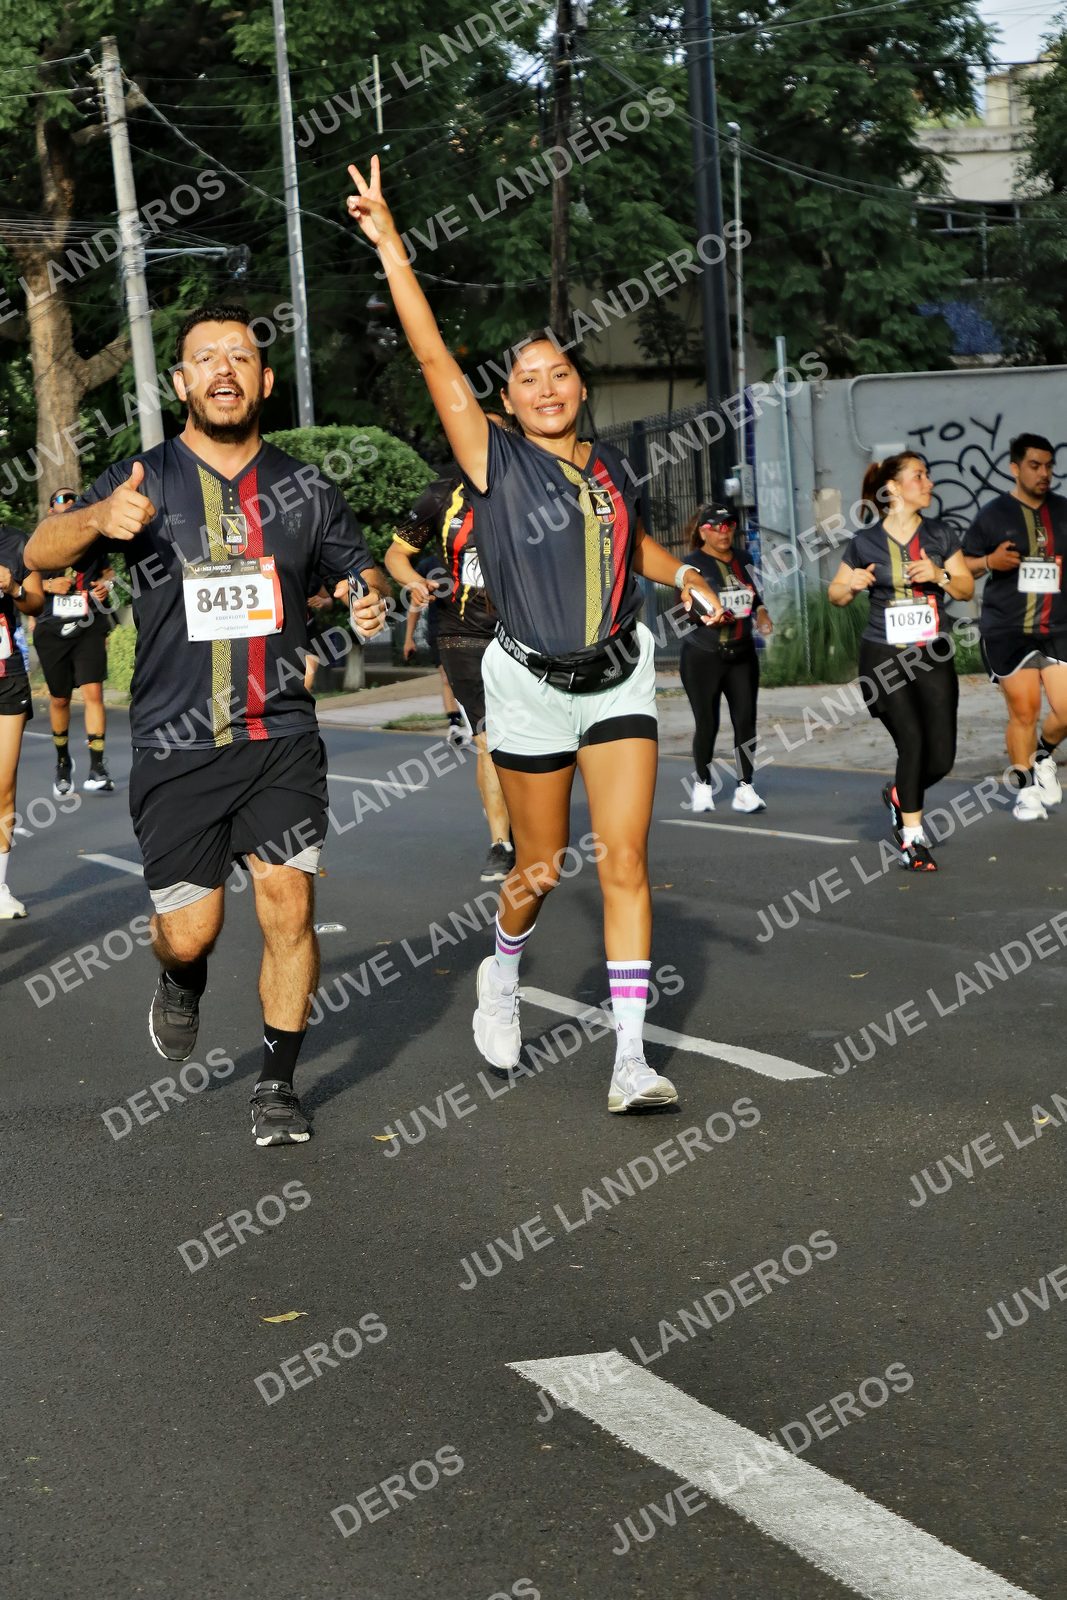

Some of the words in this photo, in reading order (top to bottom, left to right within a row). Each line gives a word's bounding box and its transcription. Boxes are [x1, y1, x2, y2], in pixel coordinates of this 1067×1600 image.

[908, 413, 1002, 450] TOY
[1022, 567, 1056, 579] 12721
[196, 584, 260, 613] 8433
[889, 611, 932, 627] 10876
